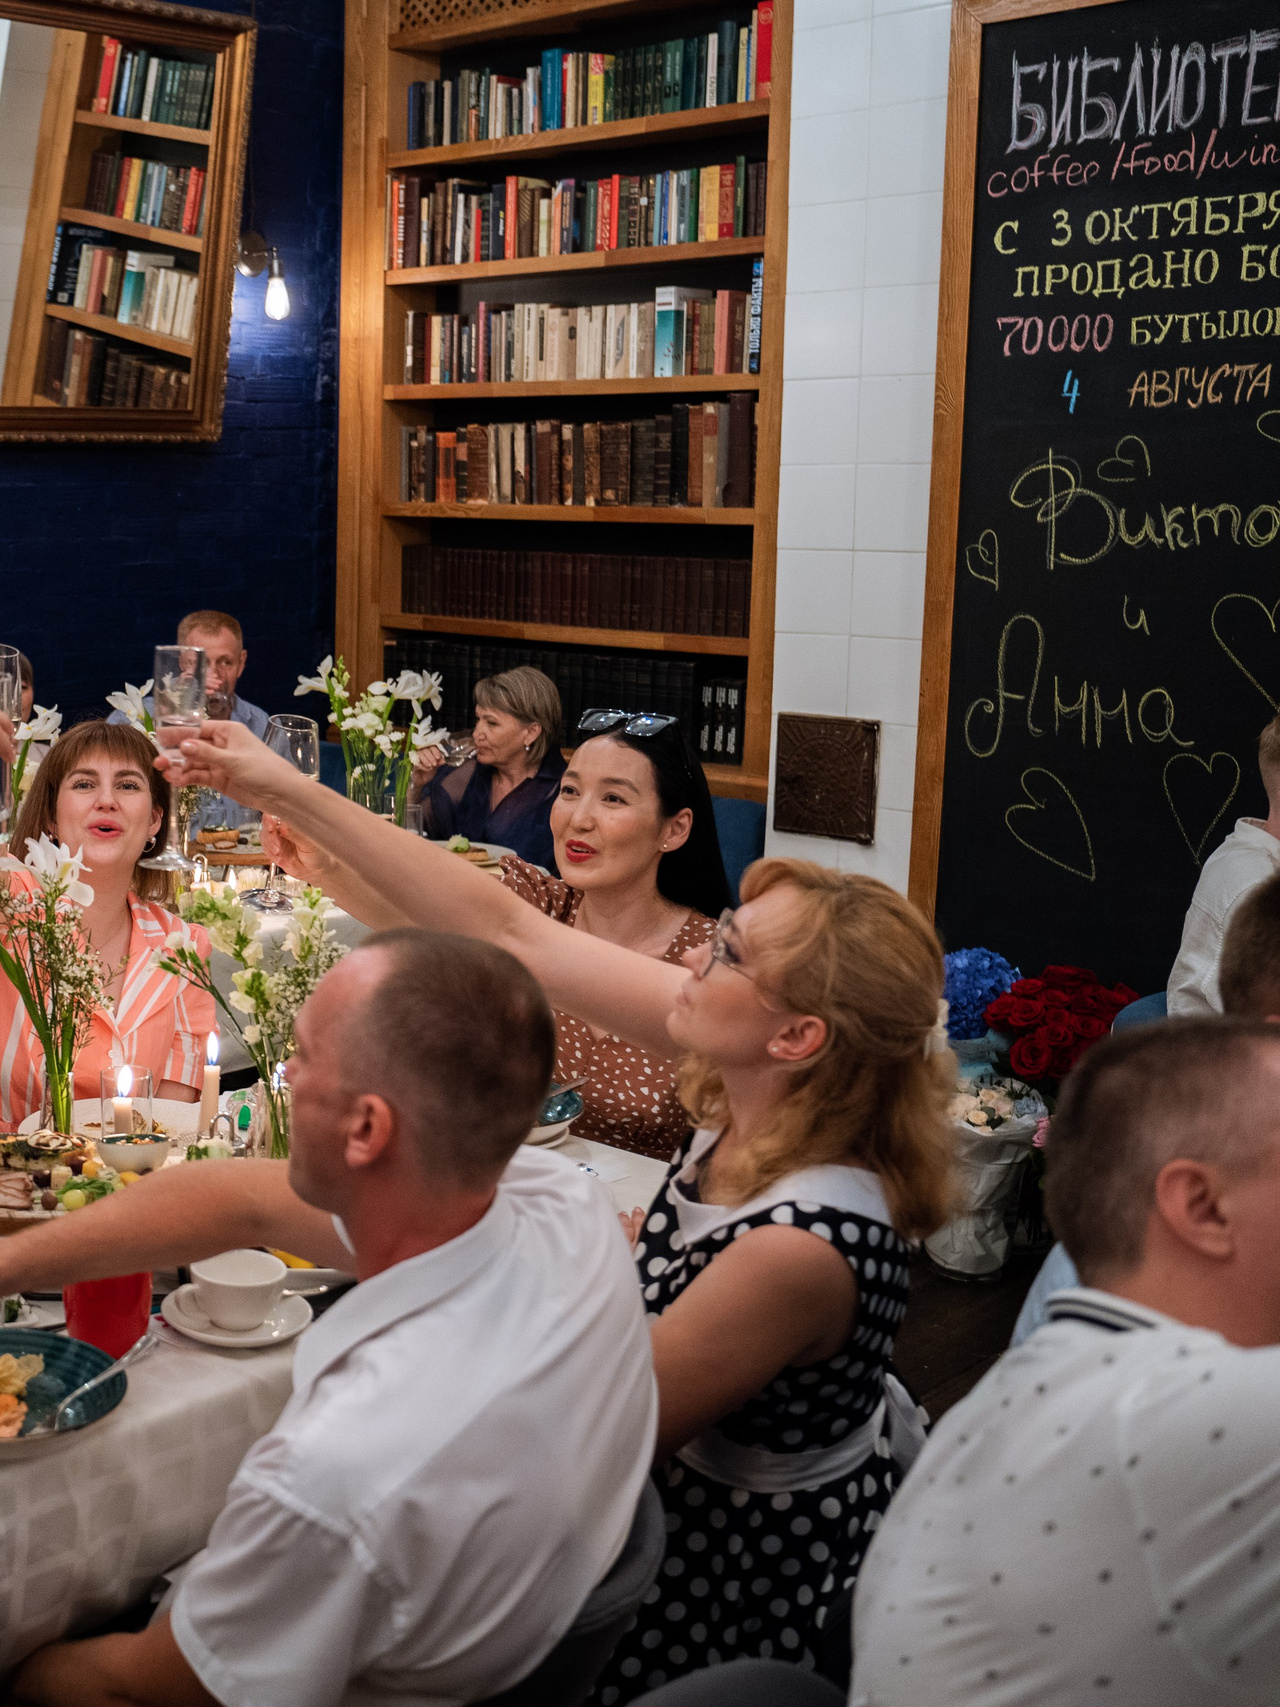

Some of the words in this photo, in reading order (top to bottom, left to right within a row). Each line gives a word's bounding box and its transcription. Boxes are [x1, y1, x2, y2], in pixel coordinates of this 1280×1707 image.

[1006, 27, 1280, 154] БИБЛИОТЕ
[1051, 208, 1072, 247] 3
[1084, 190, 1280, 246] ОКТЯБРЯ
[750, 278, 763, 315] ФАКТЫ
[749, 316, 761, 353] ТОЛЬКО
[997, 314, 1114, 356] 70000
[1130, 306, 1280, 346] БУТЫЛО
[1061, 369, 1080, 413] 4
[1127, 363, 1272, 409] АВГУСТА
[965, 613, 1194, 758] Анна
